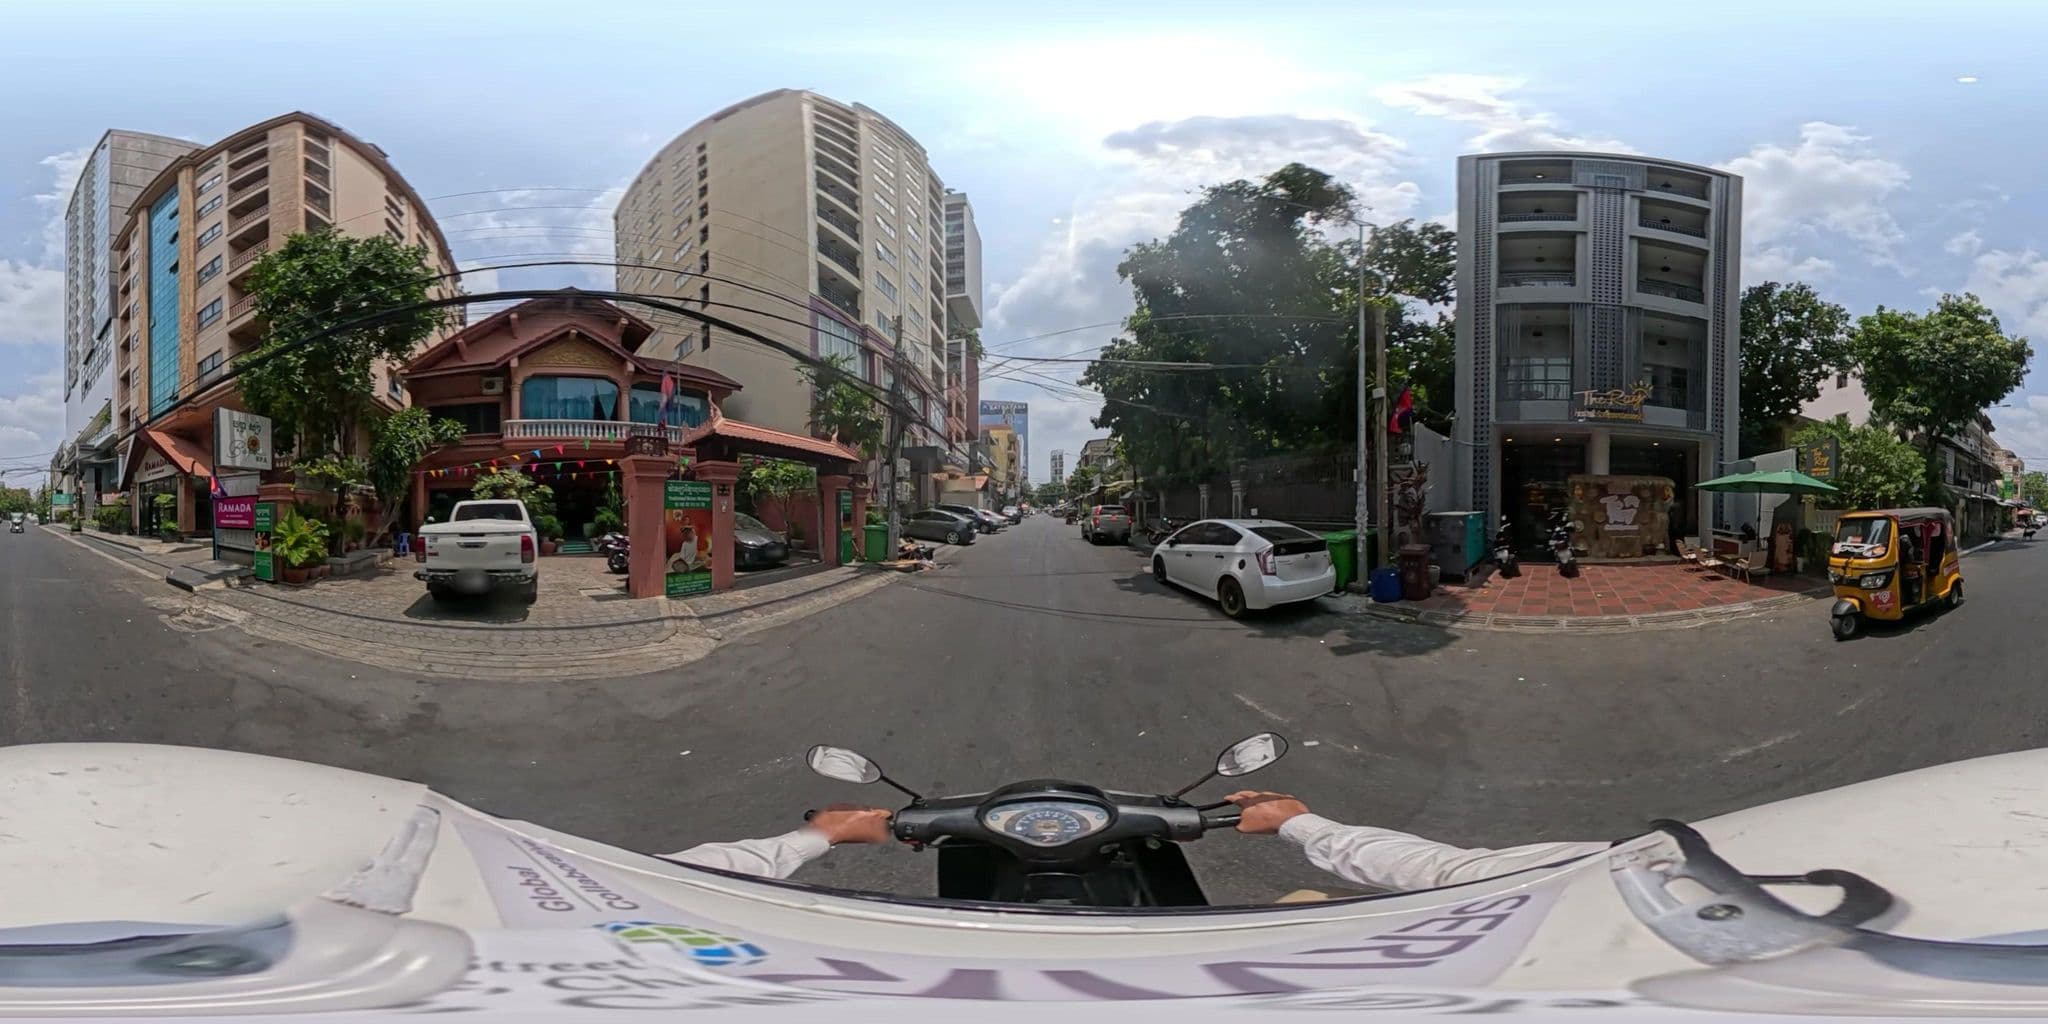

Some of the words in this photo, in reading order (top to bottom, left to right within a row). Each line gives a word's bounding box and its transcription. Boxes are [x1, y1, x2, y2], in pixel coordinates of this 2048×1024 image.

[1573, 389, 1604, 406] The
[1603, 389, 1649, 411] Ray
[218, 502, 251, 512] RAMADA
[507, 865, 576, 912] Global
